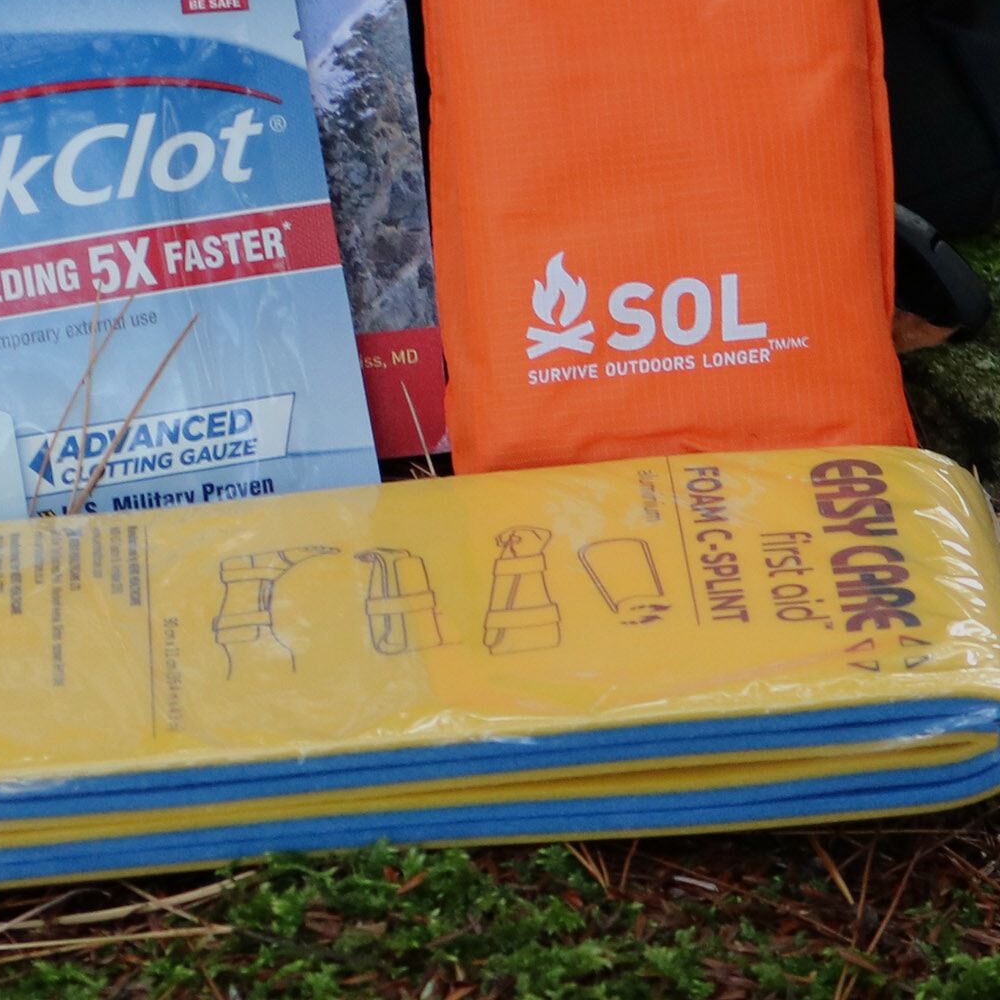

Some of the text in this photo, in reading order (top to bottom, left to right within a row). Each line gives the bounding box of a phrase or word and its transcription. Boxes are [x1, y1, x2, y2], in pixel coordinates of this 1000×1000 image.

[188, 0, 206, 11] BE
[88, 236, 158, 294] 5X
[66, 314, 126, 340] external
[130, 310, 158, 328] use
[606, 273, 768, 351] SOL
[360, 348, 419, 370] ss, MD
[528, 363, 599, 386] SURVIVE
[605, 354, 696, 378] OUTDOORS
[702, 348, 771, 369] LONGER
[56, 408, 254, 464] ADVANCED
[180, 437, 258, 467] GAUZE
[112, 489, 195, 512] Military
[202, 477, 274, 503] Proven
[684, 466, 750, 623] FOAM C-SPLINT
[760, 531, 814, 578] first
[810, 459, 922, 633] EASY CARE
